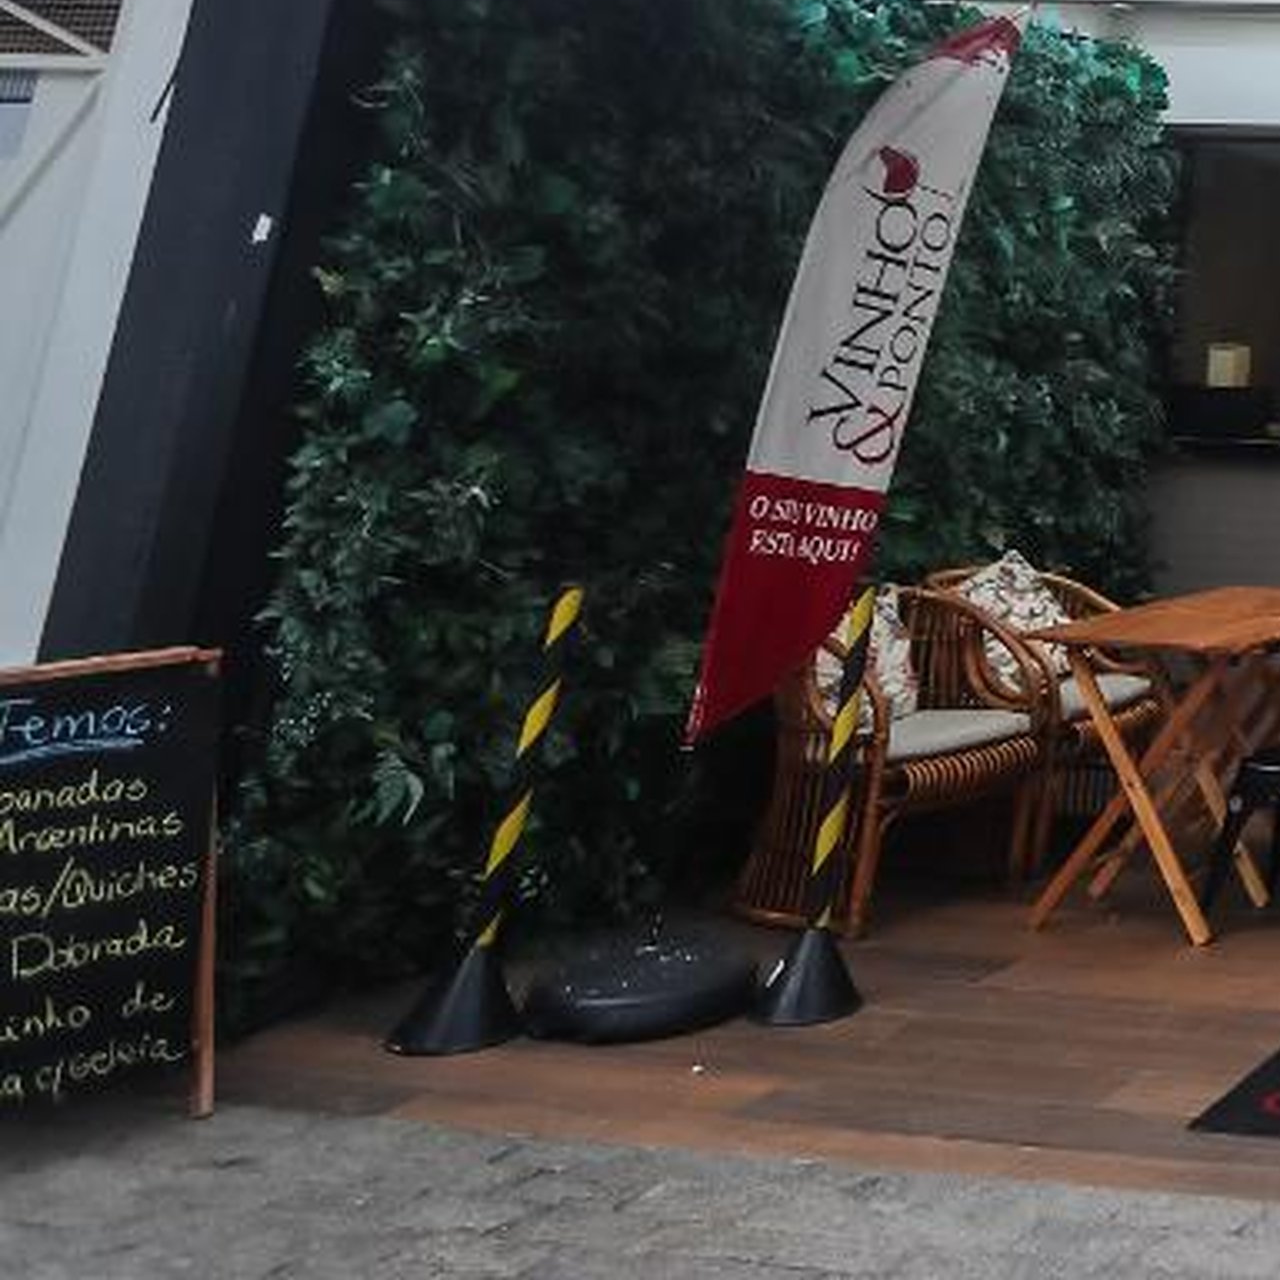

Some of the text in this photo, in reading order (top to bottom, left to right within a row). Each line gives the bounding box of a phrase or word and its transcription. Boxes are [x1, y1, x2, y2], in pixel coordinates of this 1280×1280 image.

[806, 195, 919, 424] VINHO
[830, 211, 954, 467] & PONTO
[749, 495, 770, 519] O
[805, 503, 878, 533] VINHO
